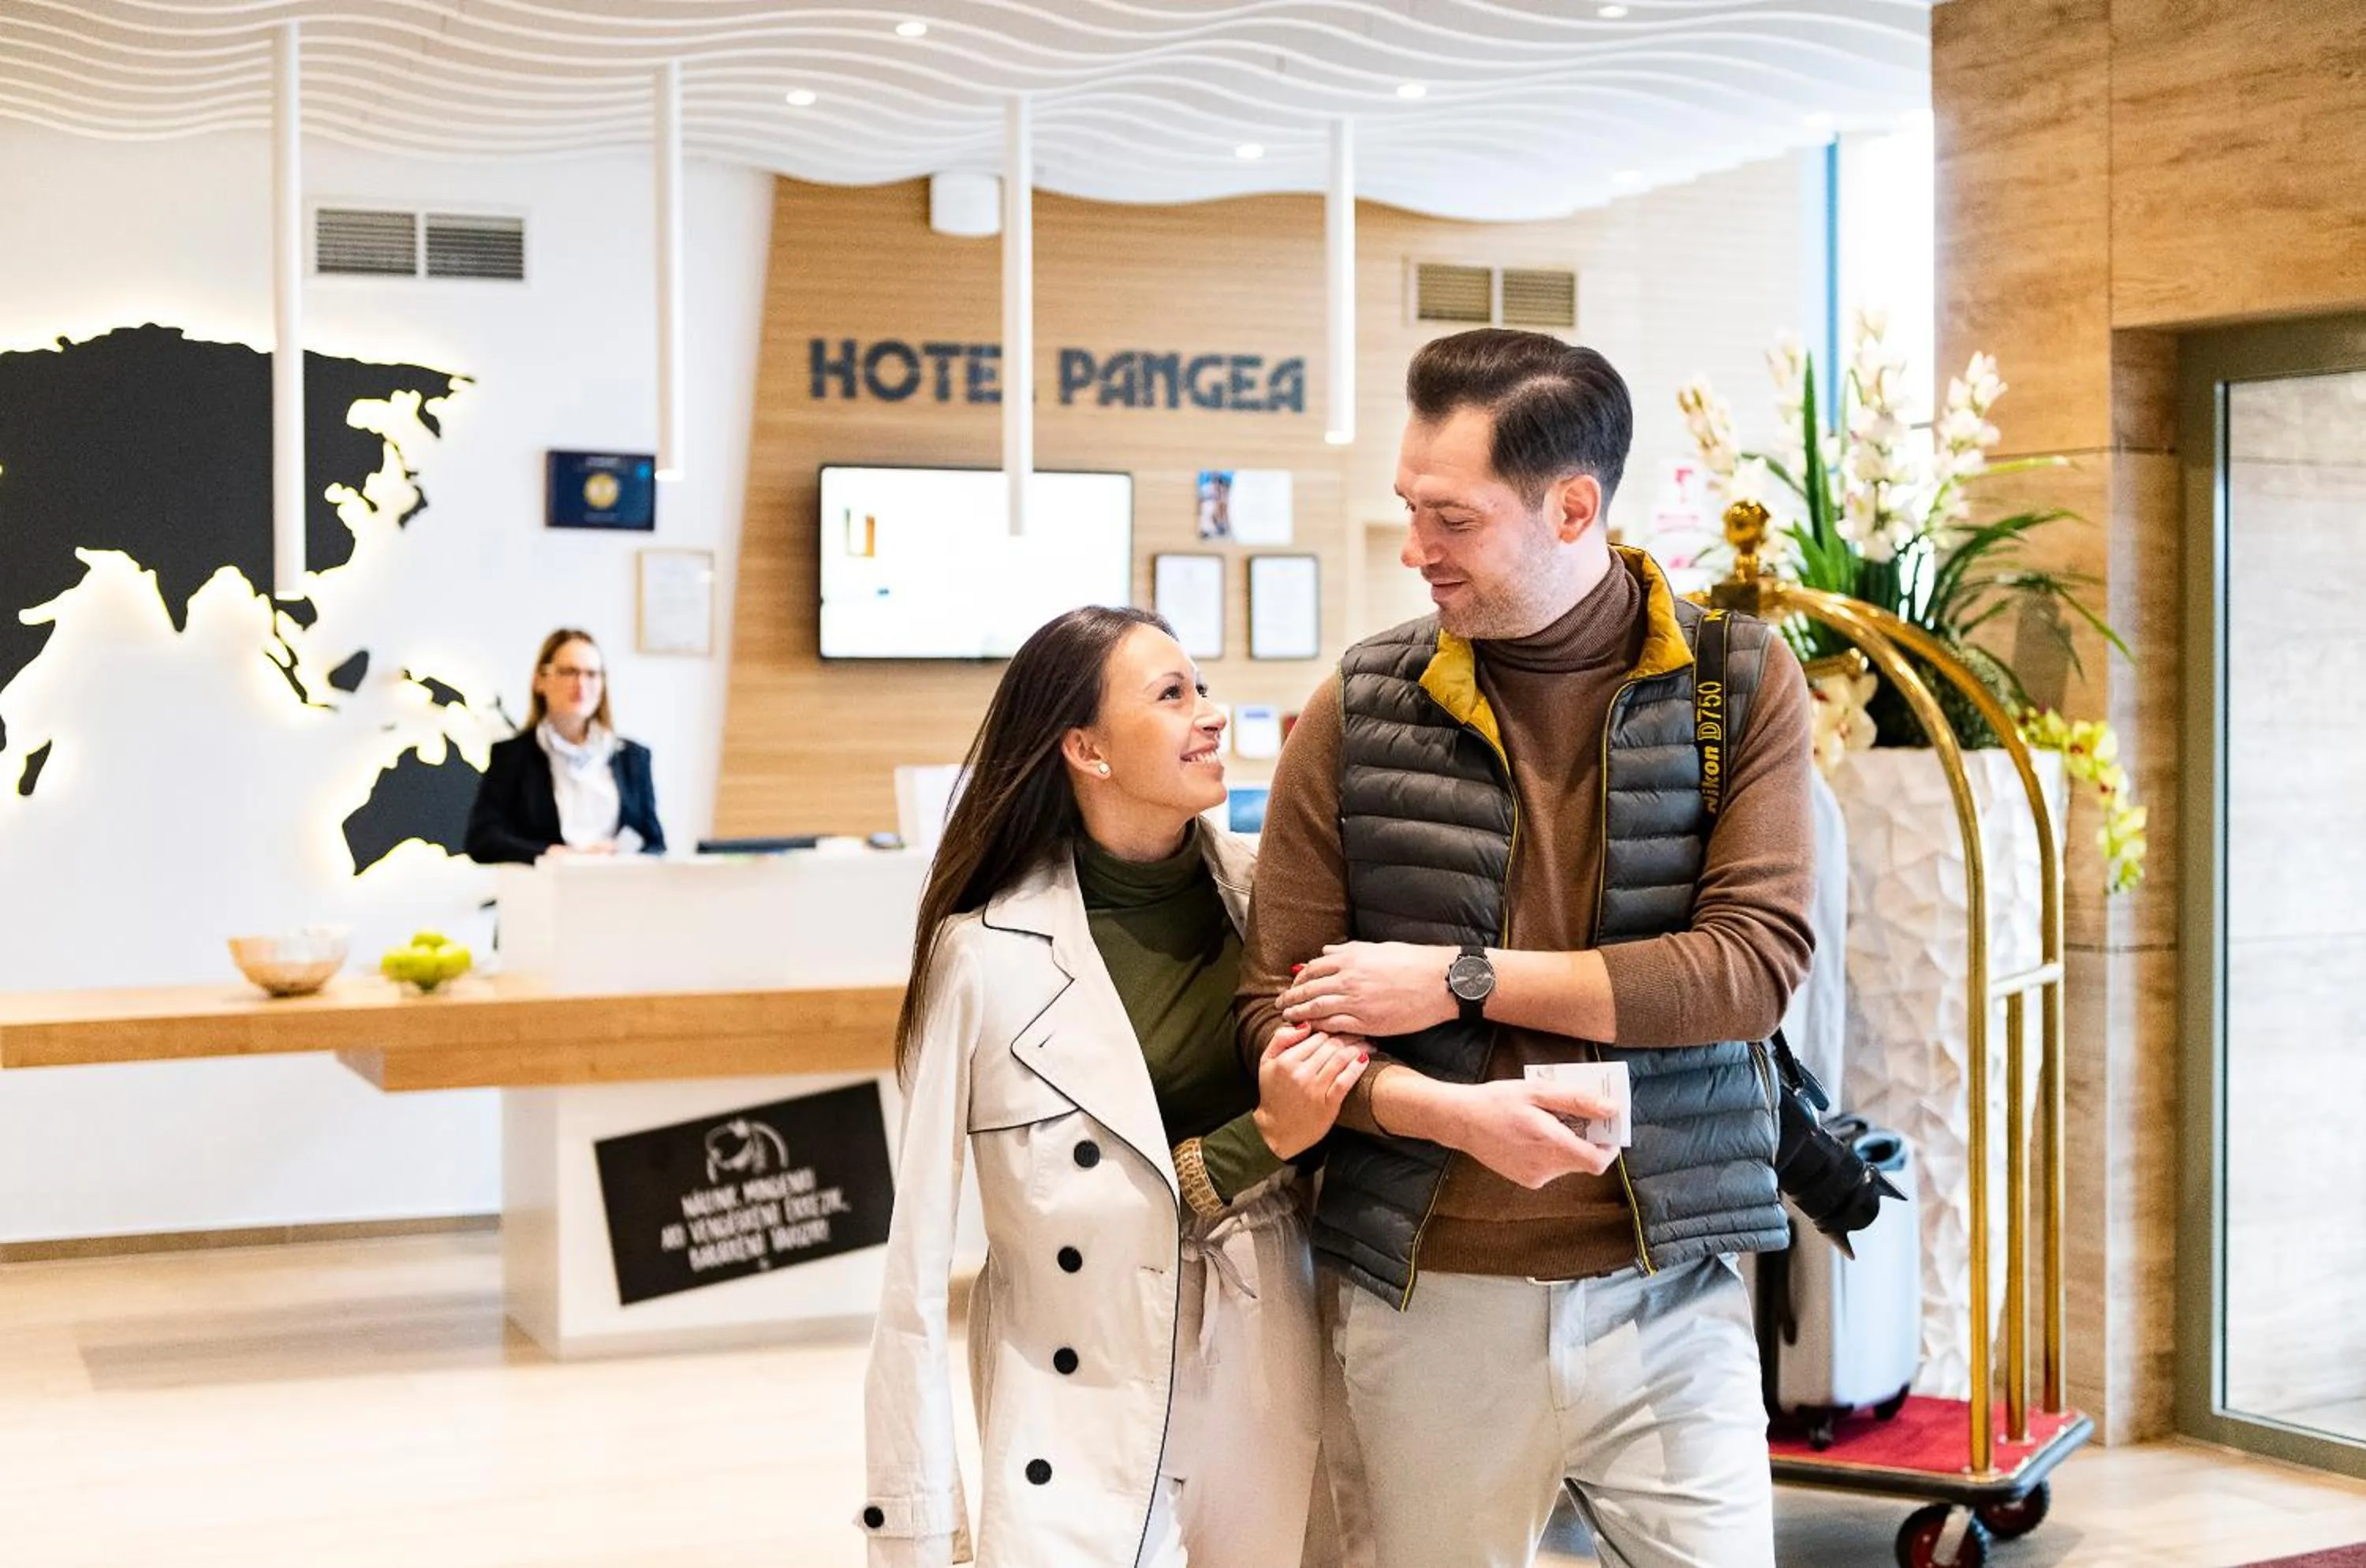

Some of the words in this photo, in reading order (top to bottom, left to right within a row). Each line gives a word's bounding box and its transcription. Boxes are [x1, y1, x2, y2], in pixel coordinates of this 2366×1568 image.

[810, 340, 1036, 403] HOTE
[1059, 349, 1305, 413] PANGEA
[1696, 681, 1722, 741] D750
